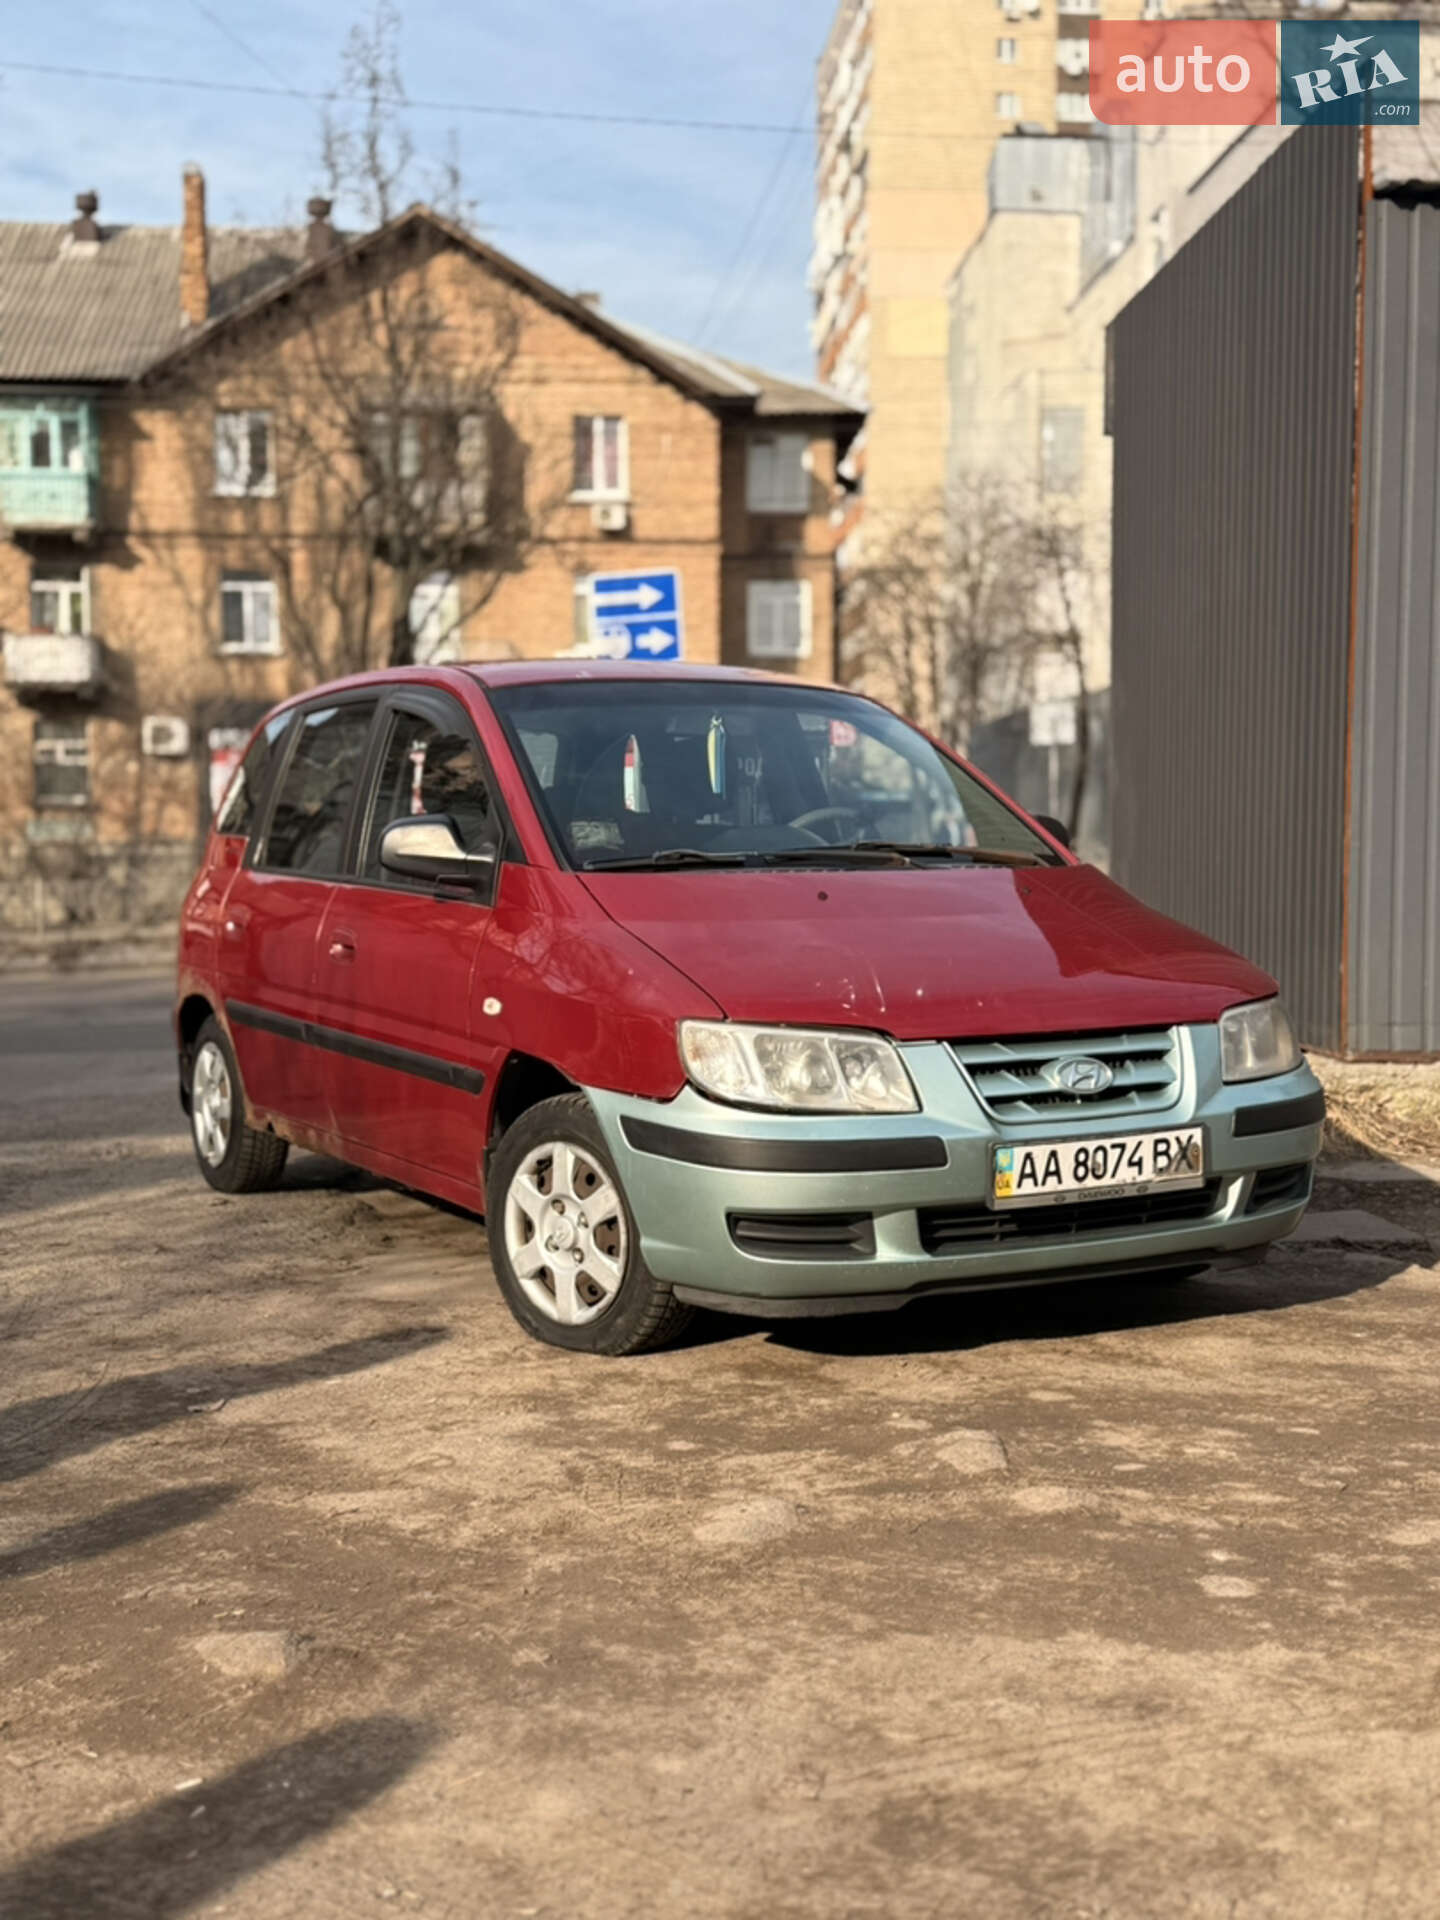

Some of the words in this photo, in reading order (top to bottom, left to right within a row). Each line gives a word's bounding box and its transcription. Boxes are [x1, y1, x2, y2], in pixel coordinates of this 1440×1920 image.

[1016, 1149, 1063, 1189] AA
[1073, 1140, 1144, 1183] 8074
[1152, 1134, 1194, 1175] BX
